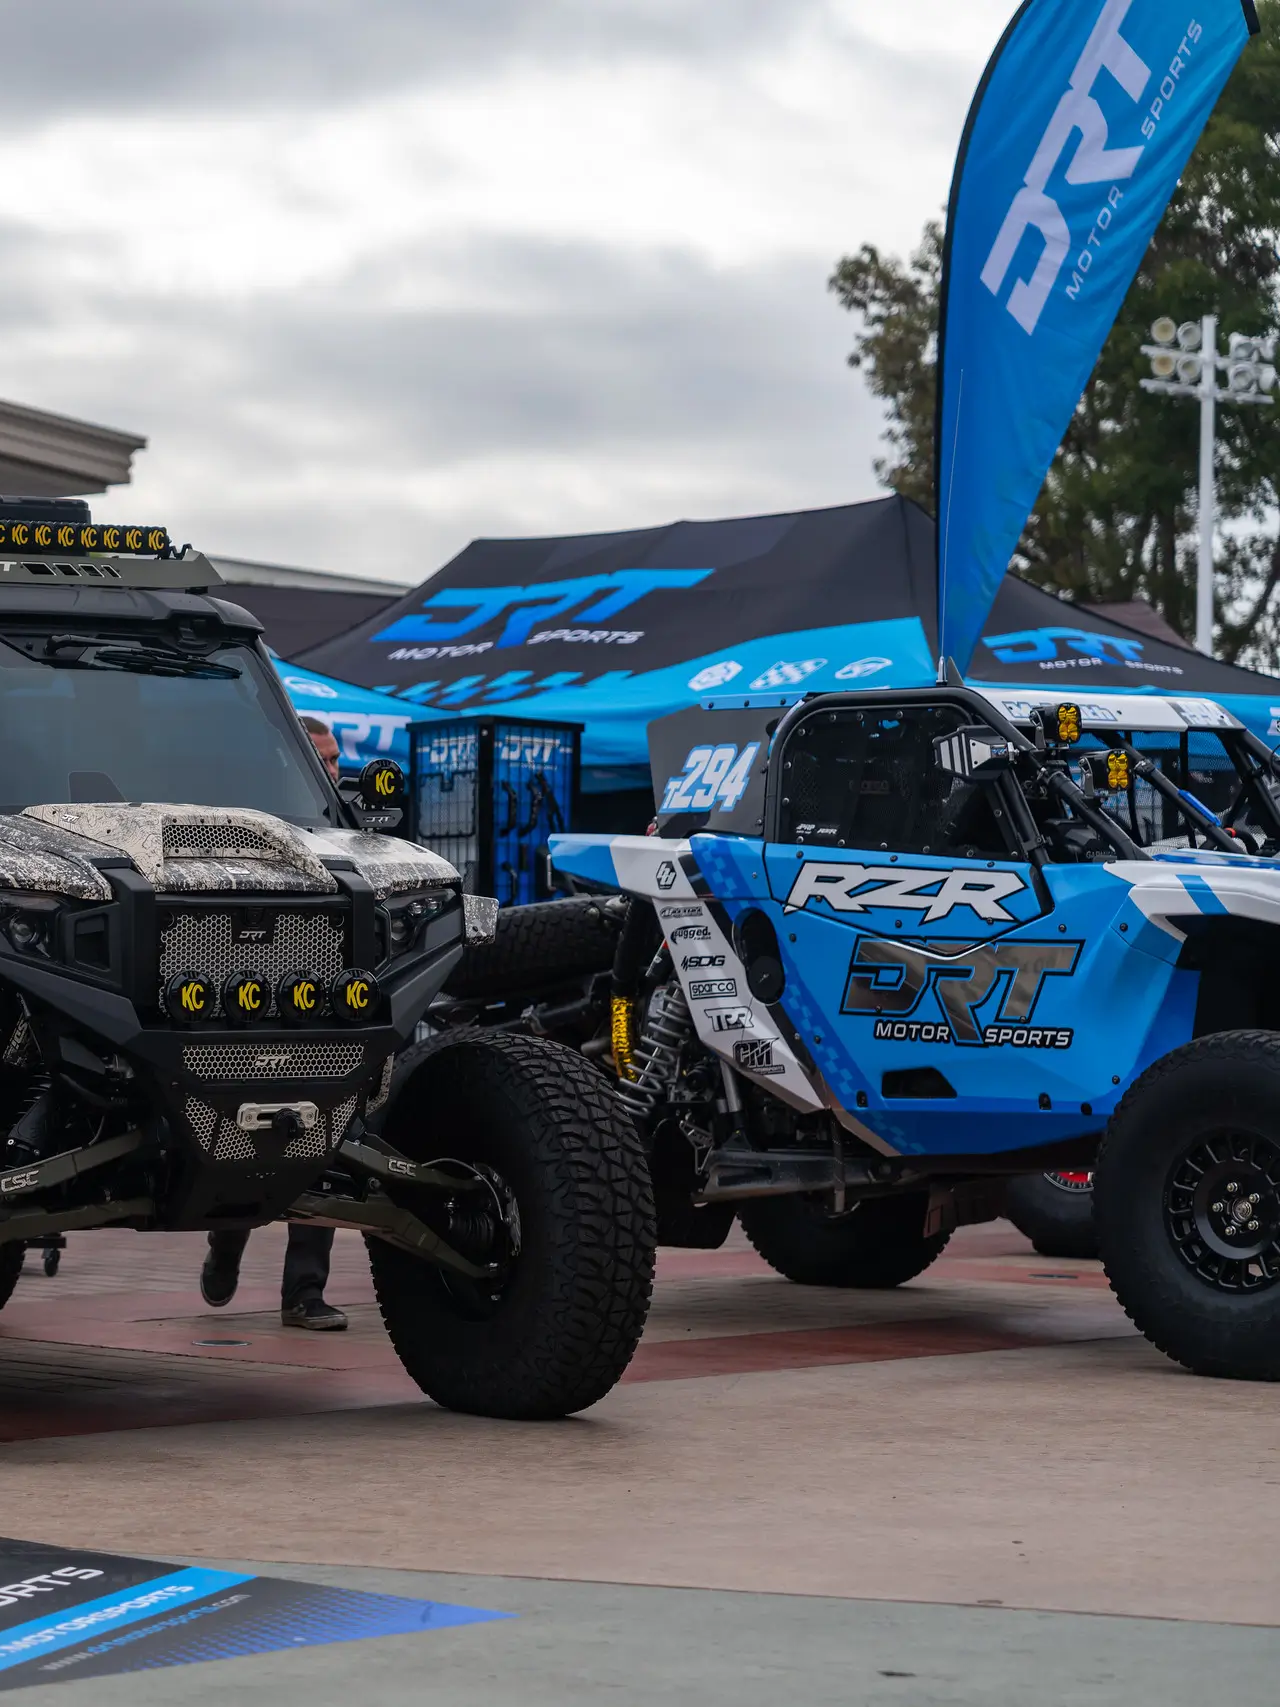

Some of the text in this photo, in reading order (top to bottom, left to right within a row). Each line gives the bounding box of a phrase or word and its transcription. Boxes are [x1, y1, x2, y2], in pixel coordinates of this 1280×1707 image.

[979, 0, 1152, 337] DRT
[1065, 19, 1203, 300] MOTOR SPORTS
[12, 524, 28, 544] KC
[35, 525, 51, 545] KC
[58, 525, 74, 546] KC
[81, 527, 97, 547] KC
[104, 528, 119, 548] KC
[126, 529, 142, 548] KC
[149, 530, 164, 550] KC
[370, 568, 716, 649] DRT
[388, 629, 646, 660] MOTOR SPORTS
[982, 626, 1145, 666] DRT
[1039, 657, 1184, 675] MOTOR SPORTS
[375, 769, 396, 796] KC
[661, 744, 760, 811] T294
[784, 860, 1029, 925] RZR
[239, 930, 267, 941] DRT
[686, 955, 726, 967] SDG
[182, 982, 204, 1011] KC
[238, 981, 260, 1010] KC
[293, 981, 315, 1010] KC
[346, 980, 368, 1009] KC
[691, 981, 734, 995] sparco
[839, 934, 1086, 1048] DRT
[876, 1022, 1071, 1047] MOTOR SPORTS
[254, 1055, 291, 1069] DRT
[388, 1158, 417, 1177] CSC
[0, 1170, 40, 1192] CSC
